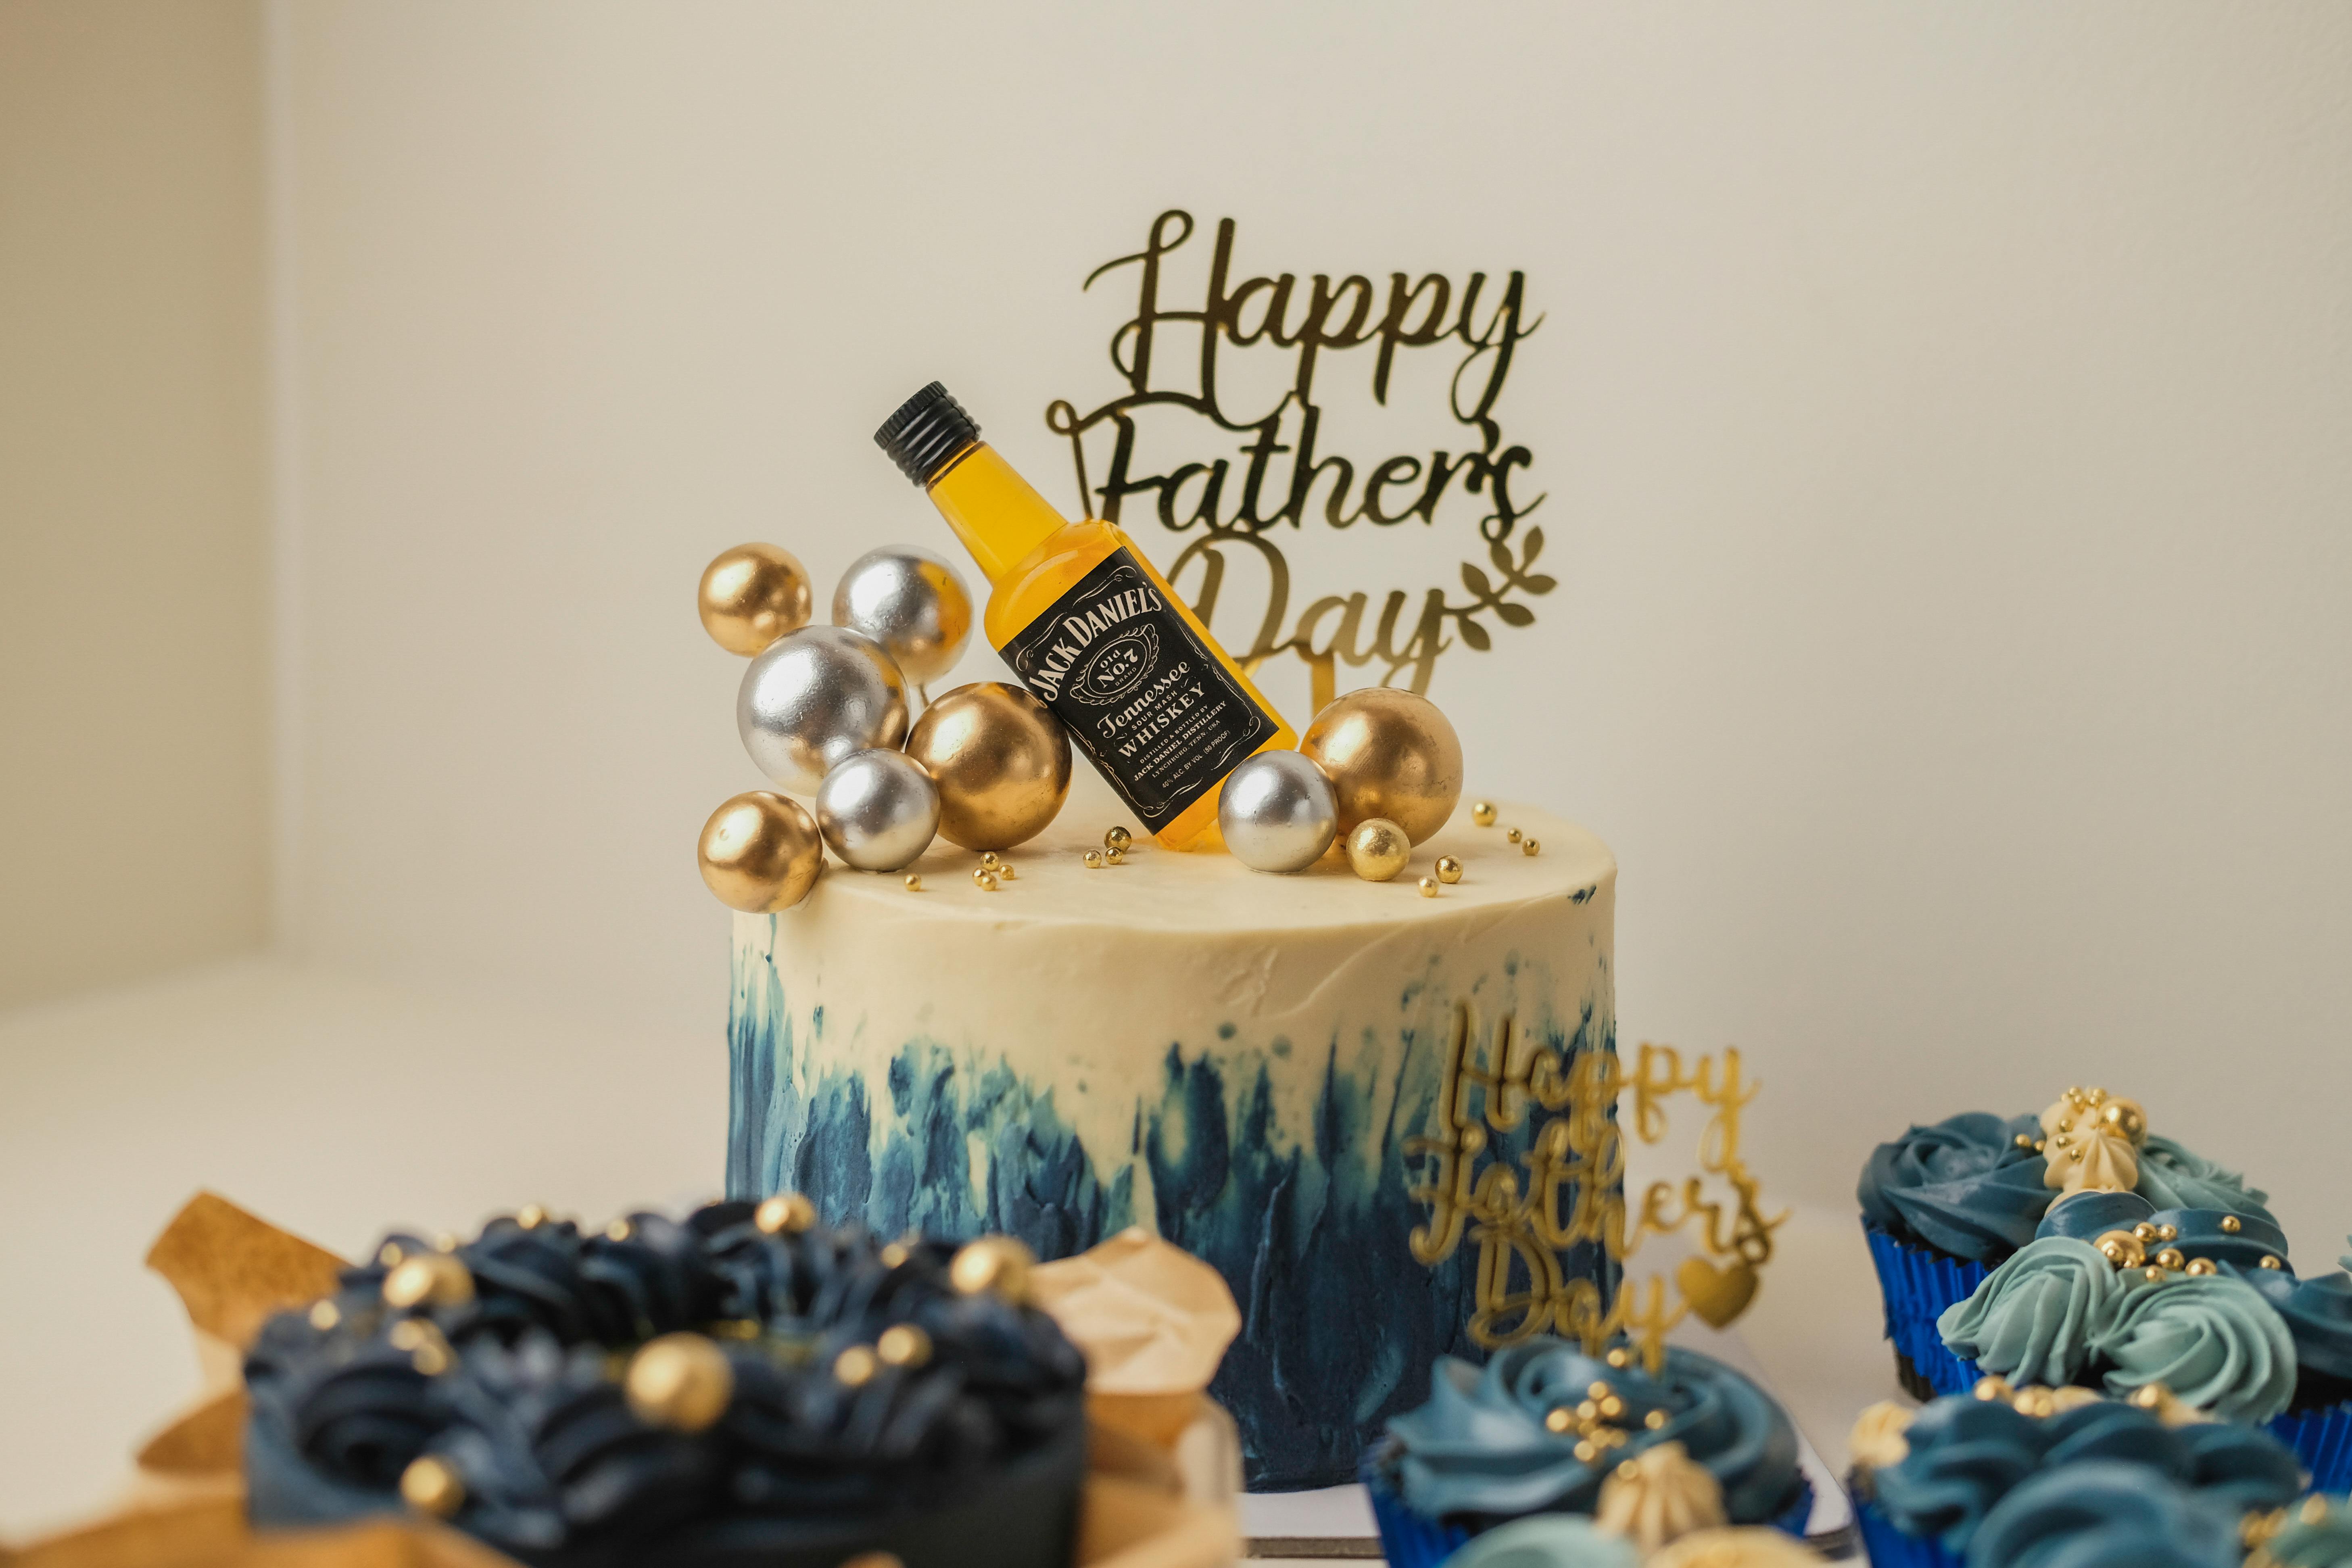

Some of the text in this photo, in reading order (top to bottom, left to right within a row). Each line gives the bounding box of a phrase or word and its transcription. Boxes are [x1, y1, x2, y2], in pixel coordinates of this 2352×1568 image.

[1083, 209, 1546, 431] Happy
[1029, 581, 1162, 702] JACK DANIEL'S
[1167, 530, 1453, 698] Day
[1097, 662, 1190, 739] Tennessee
[1115, 666, 1137, 687] BRAND
[1131, 691, 1177, 731] SOUR MASH
[1118, 682, 1205, 758] WHISKEY
[1134, 701, 1227, 781] JACK DANIEL DISTILLERY
[1140, 739, 1169, 764] DISTILLED
[1175, 712, 1200, 734] BOTTLED
[1200, 704, 1208, 713] BY
[1208, 720, 1221, 731] USA
[1184, 761, 1191, 770] BY
[1439, 1001, 1761, 1173] Happy
[1468, 1222, 1688, 1381] Day
